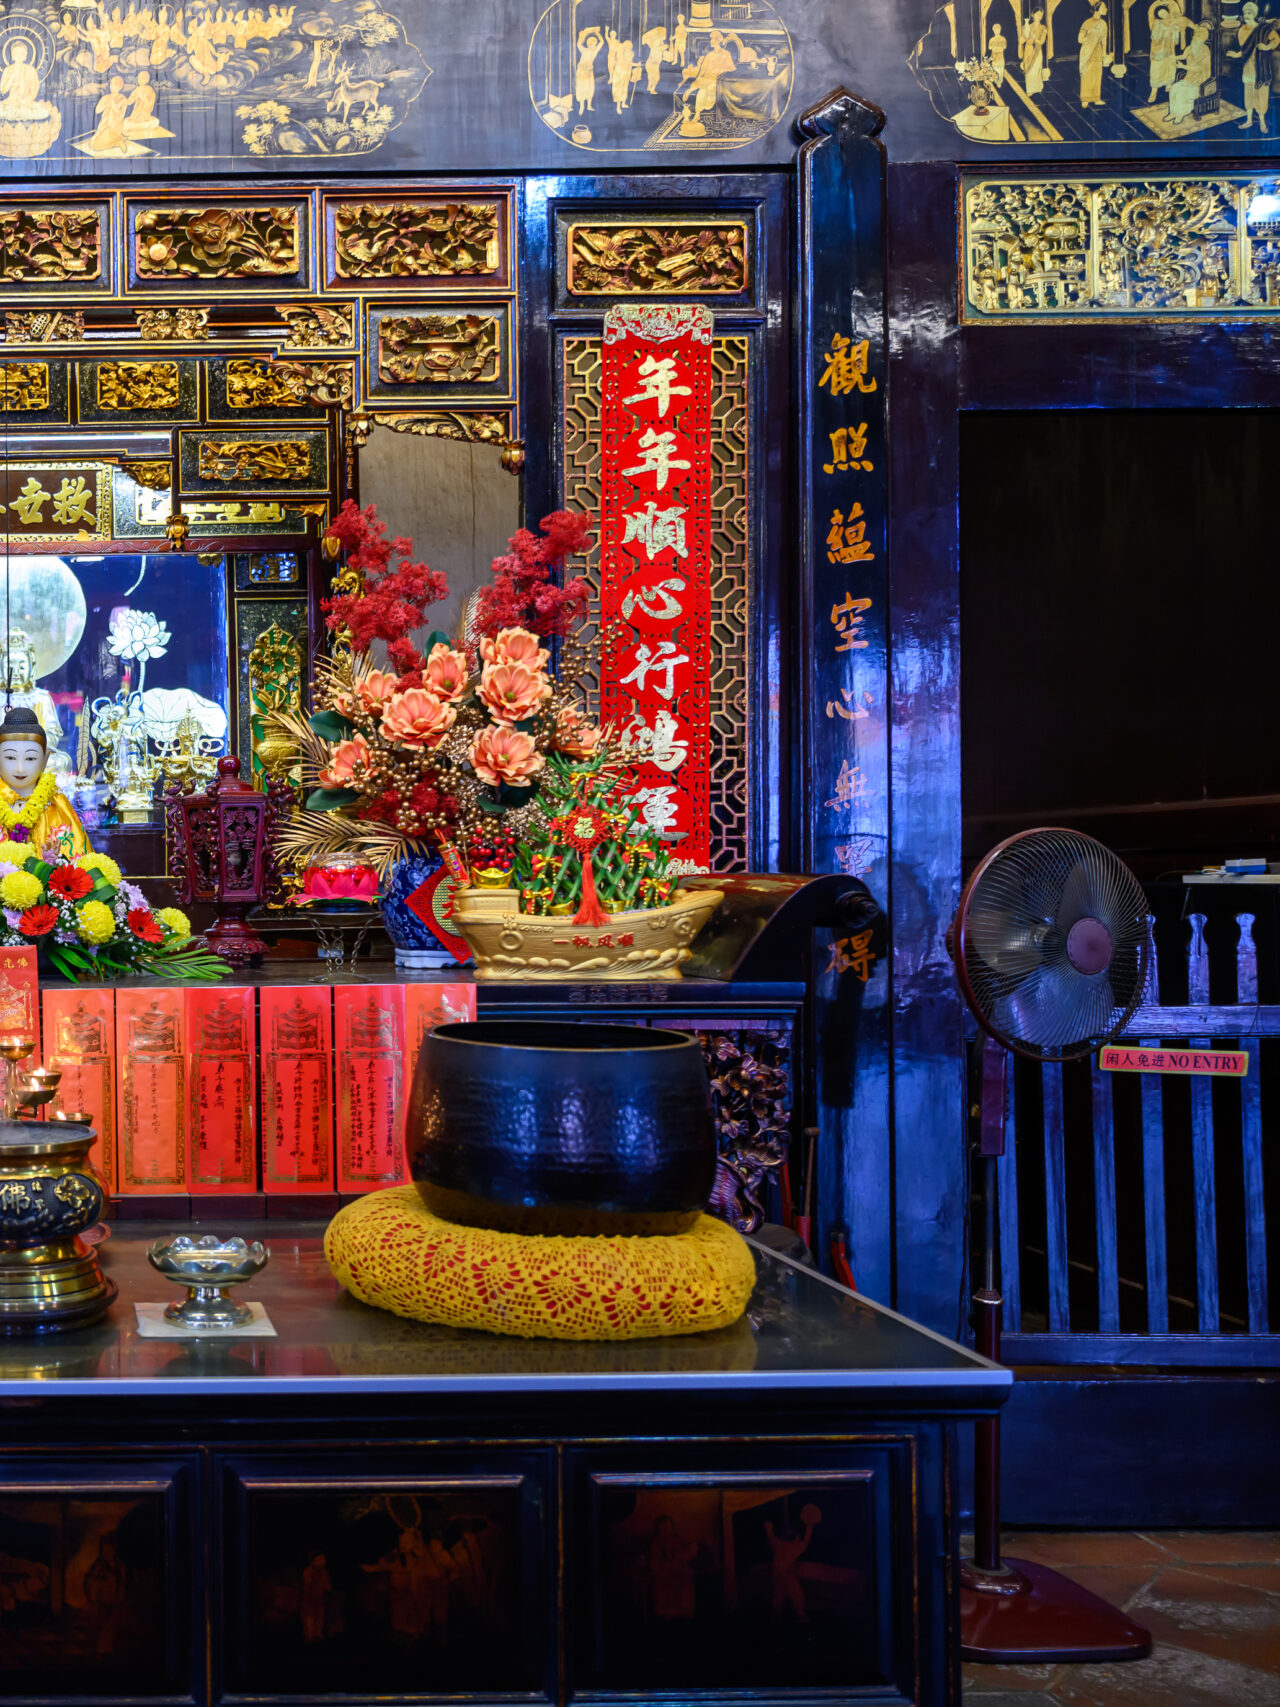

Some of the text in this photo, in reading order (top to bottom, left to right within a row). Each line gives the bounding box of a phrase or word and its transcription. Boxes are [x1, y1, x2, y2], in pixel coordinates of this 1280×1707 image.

[1105, 1052, 1242, 1070] 闲人免进 NO ENTRY
